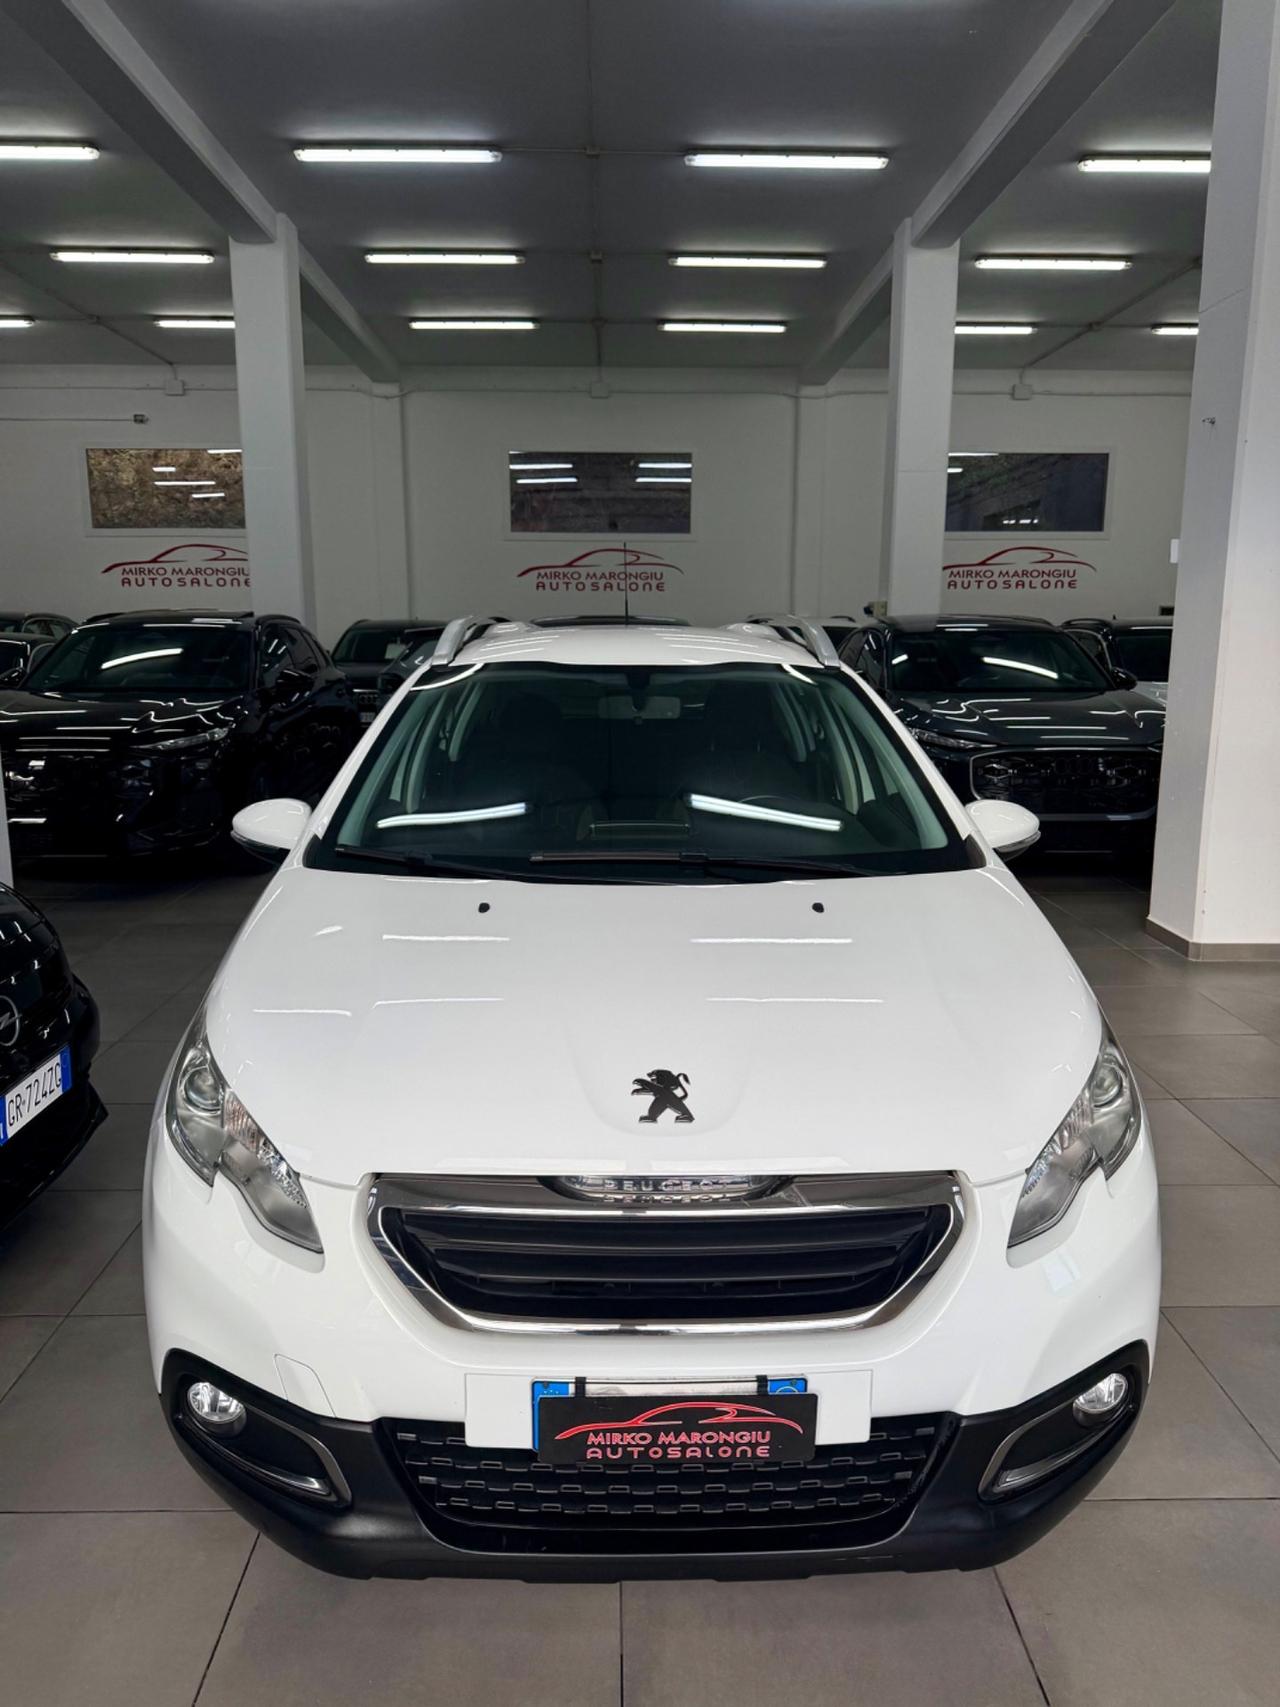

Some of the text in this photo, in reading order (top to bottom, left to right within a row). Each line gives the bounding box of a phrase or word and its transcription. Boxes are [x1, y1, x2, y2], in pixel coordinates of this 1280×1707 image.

[121, 567, 167, 577] MIRKO
[536, 571, 664, 581] MIRKO MARONGIU
[948, 569, 1077, 579] MIRKO MARONGIU
[536, 581, 665, 592] AUTOSALONE
[947, 579, 1078, 590] AUTOSALONE
[586, 1431, 771, 1446] MIRKO MARONGIU
[586, 1446, 771, 1460] AUTOSALONE
